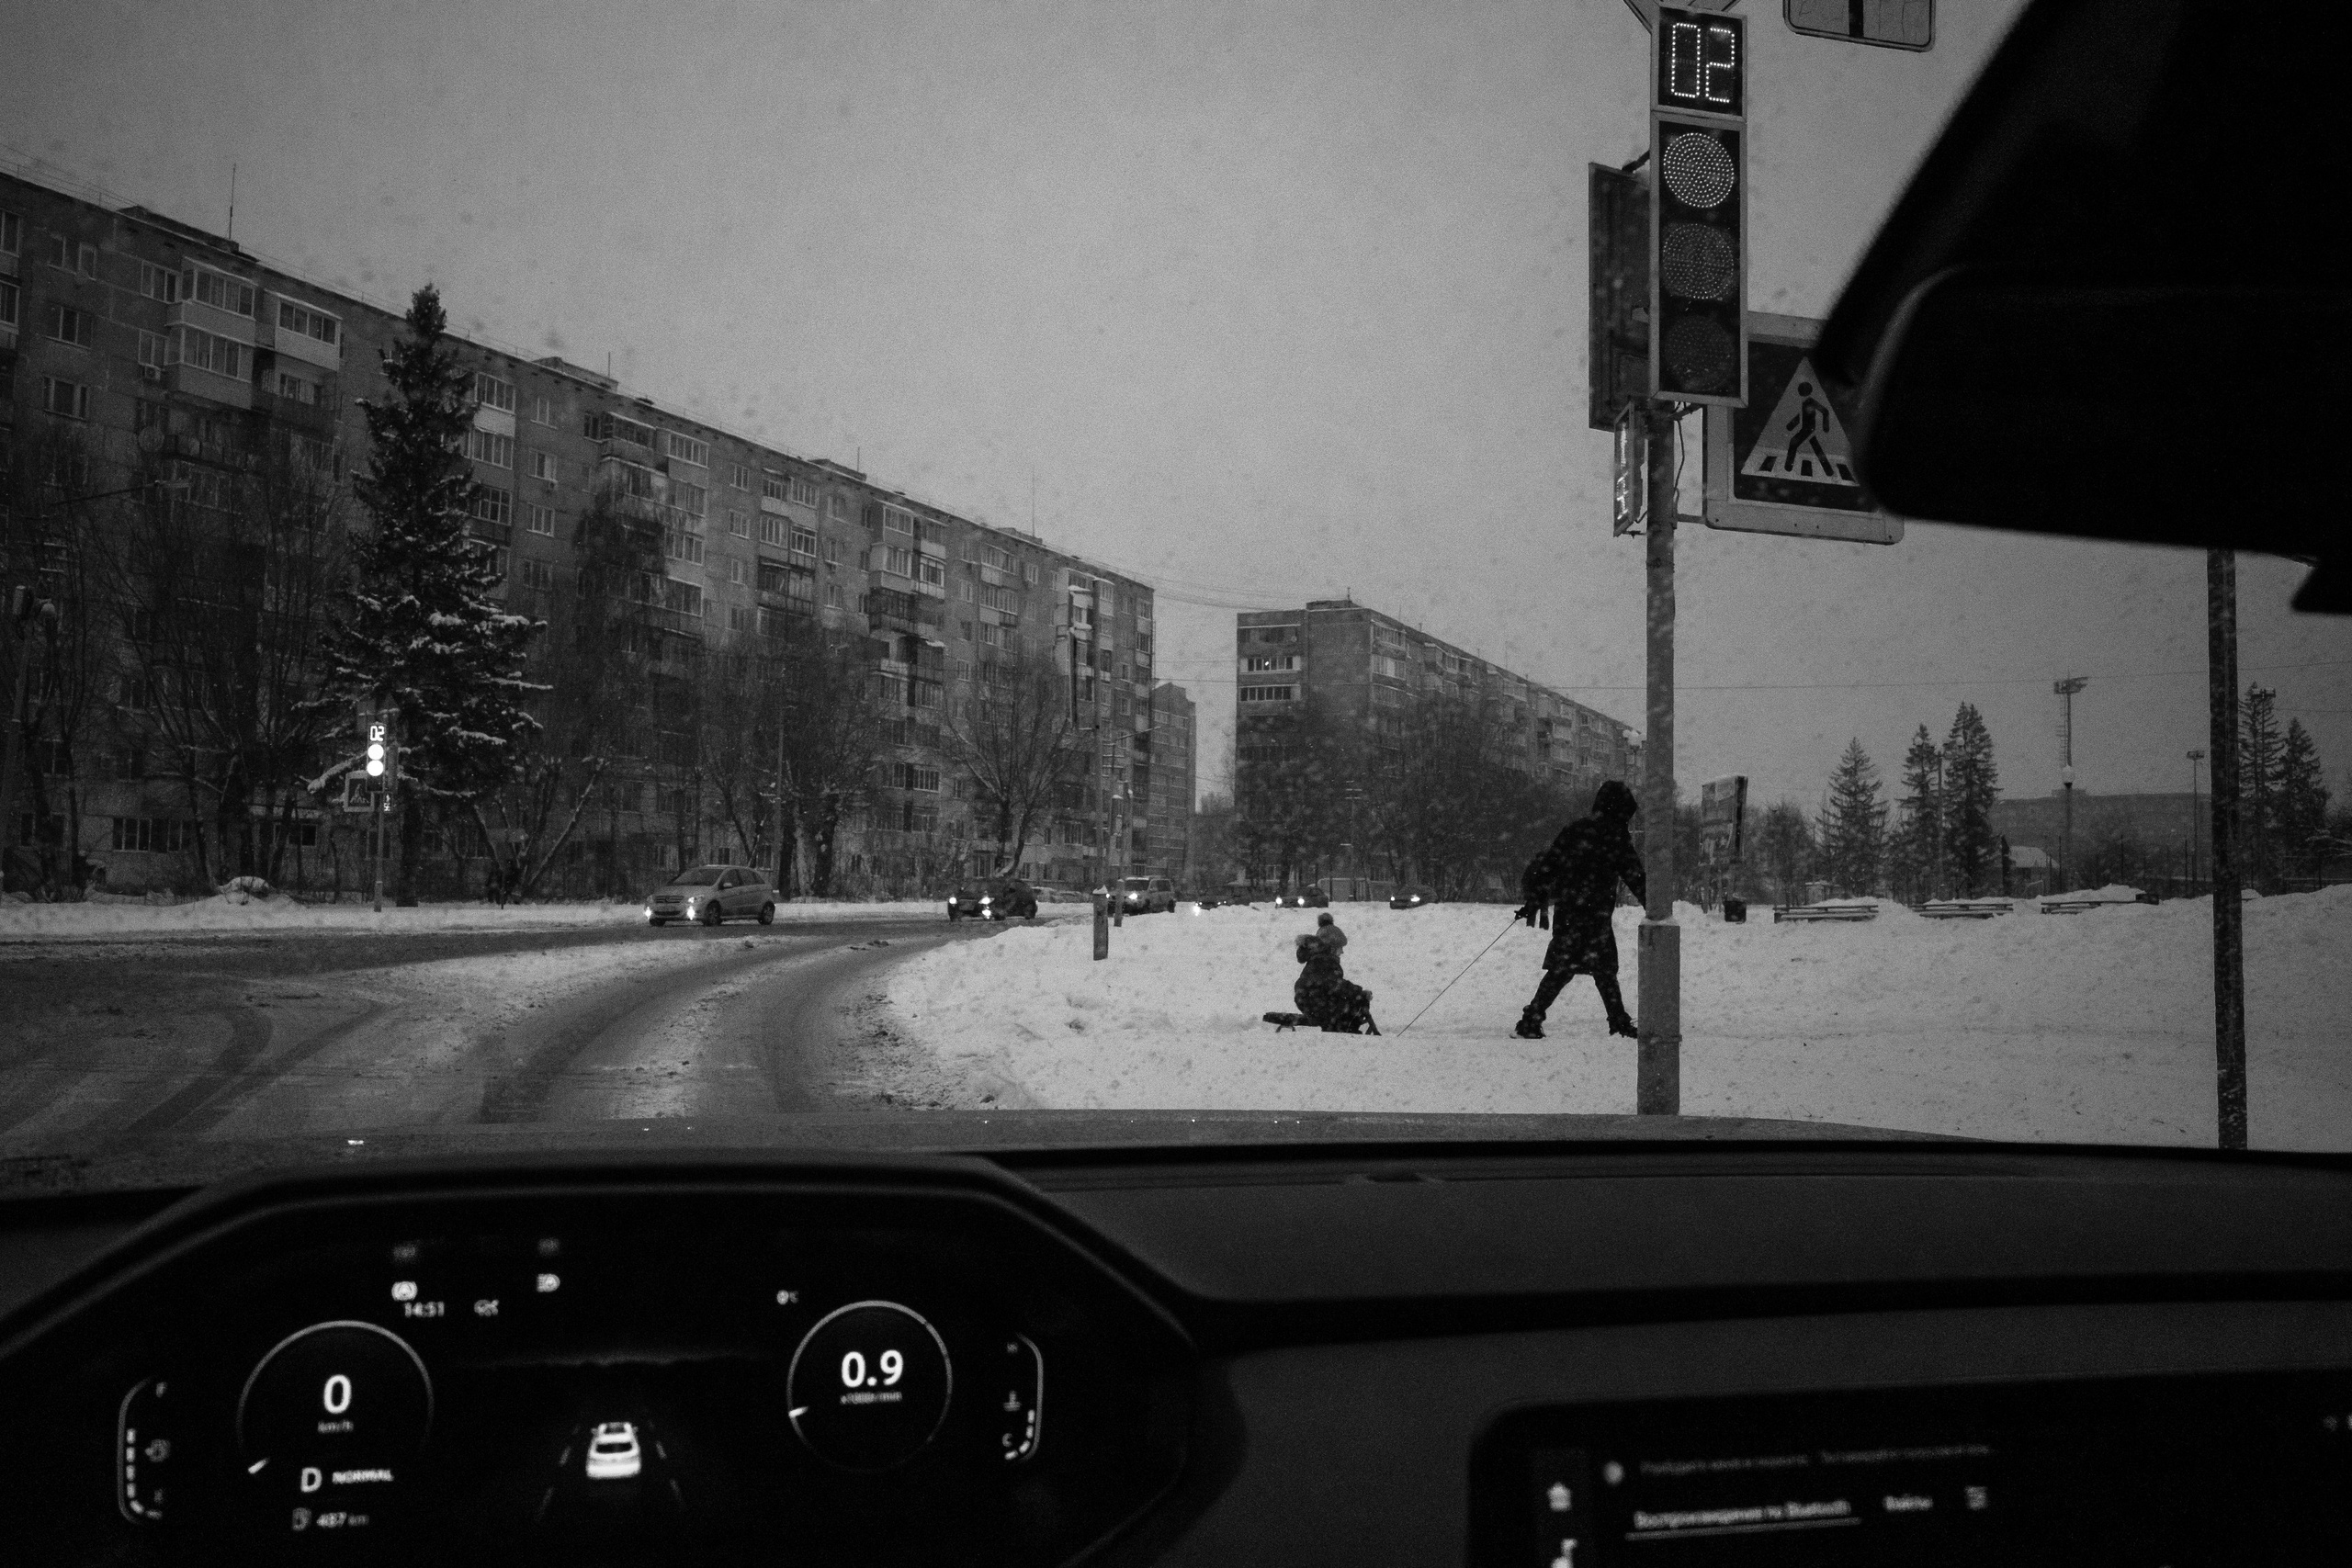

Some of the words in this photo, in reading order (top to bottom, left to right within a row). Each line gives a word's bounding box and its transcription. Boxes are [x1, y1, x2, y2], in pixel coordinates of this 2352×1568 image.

[1671, 22, 1736, 104] 02
[369, 725, 385, 742] 02
[841, 1349, 904, 1388] 0.9
[323, 1374, 352, 1414] 0
[300, 1466, 322, 1493] D
[332, 1468, 394, 1485] NORMAL
